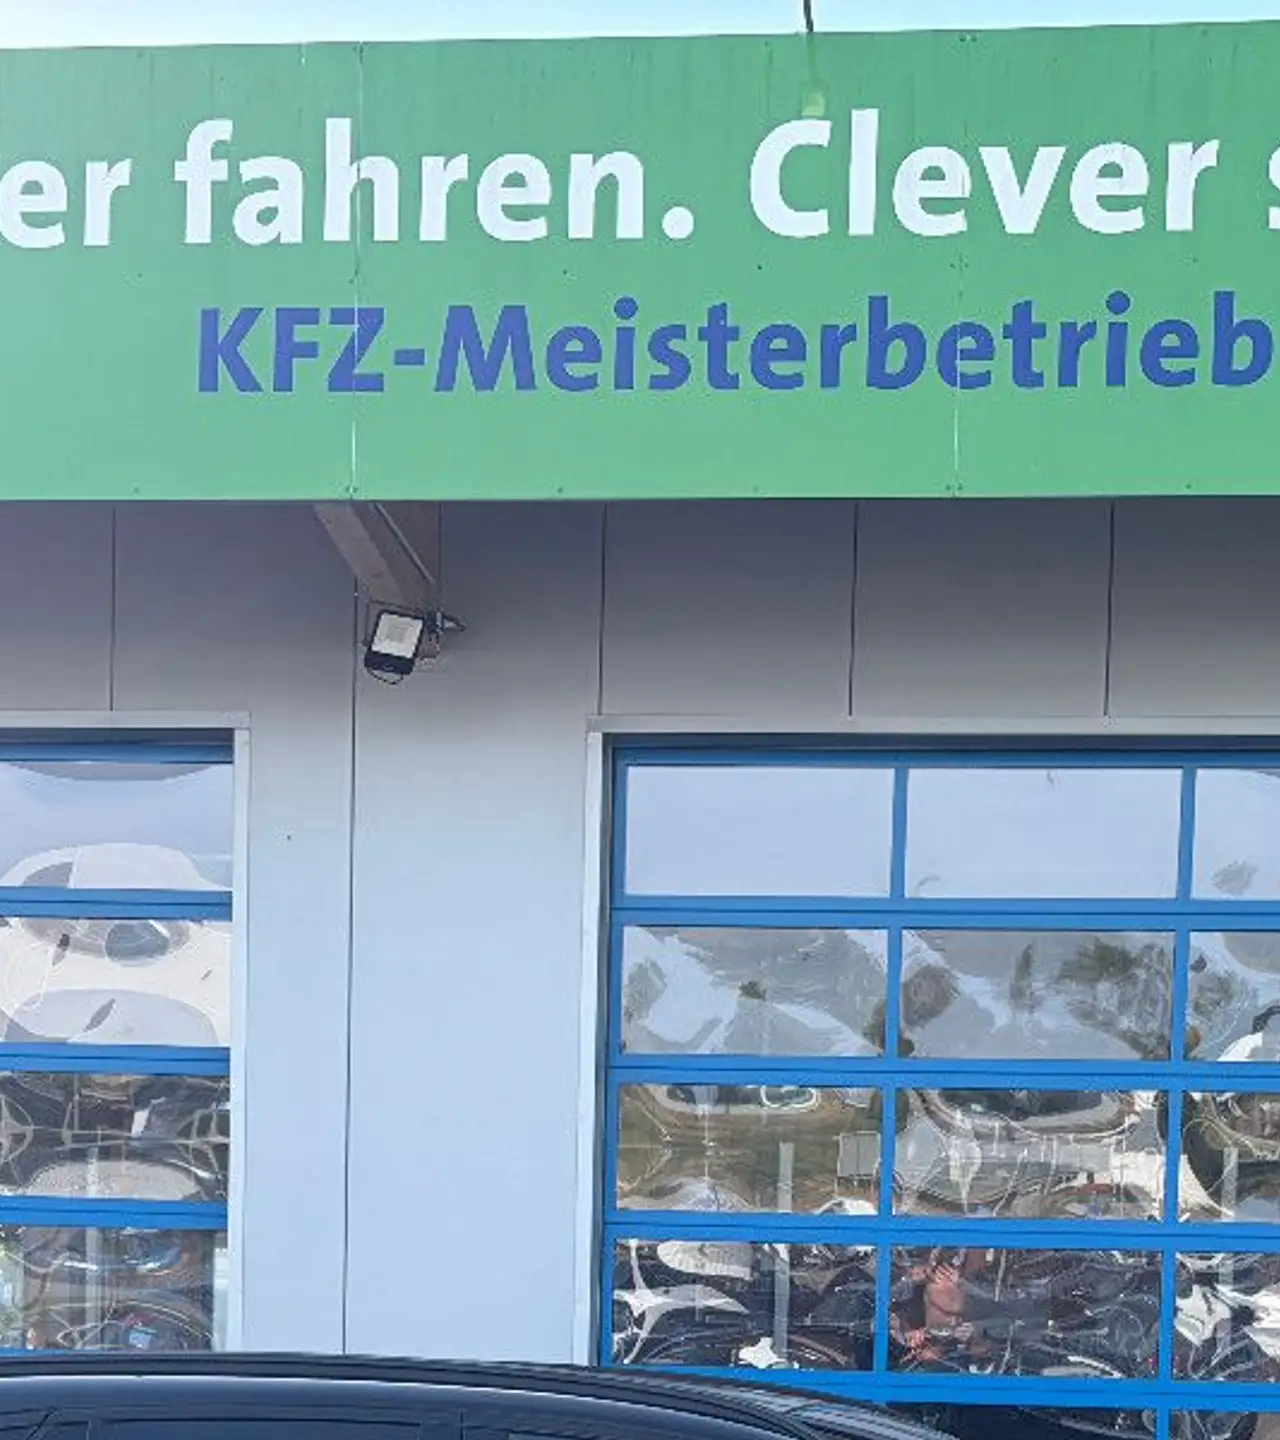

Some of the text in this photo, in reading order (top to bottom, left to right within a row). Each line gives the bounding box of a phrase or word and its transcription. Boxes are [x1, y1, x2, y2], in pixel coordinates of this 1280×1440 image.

[174, 116, 695, 246] fahren.
[749, 108, 1220, 240] Clever
[197, 294, 1274, 393] KFZ-Meisterbetrieb
